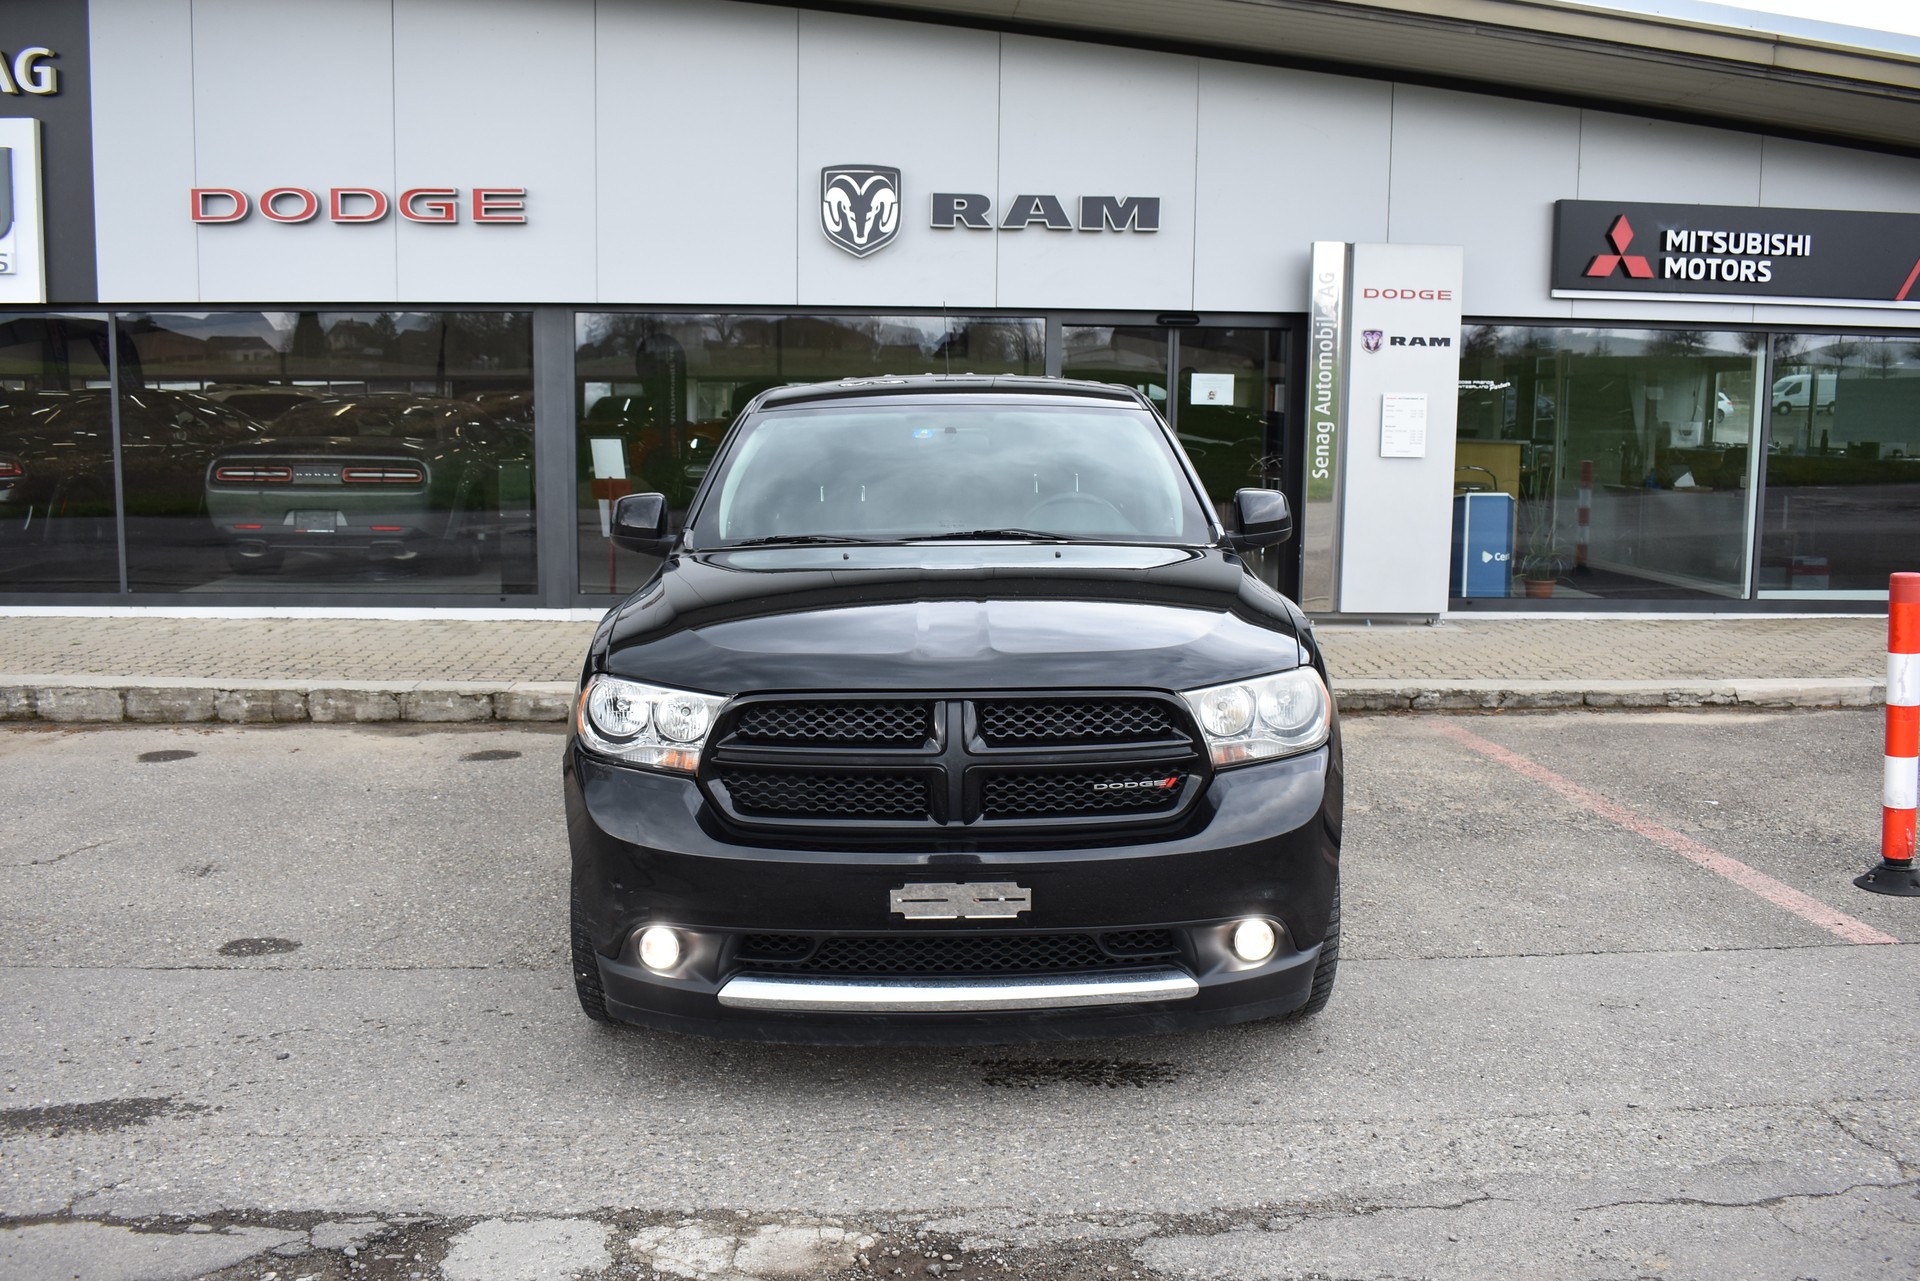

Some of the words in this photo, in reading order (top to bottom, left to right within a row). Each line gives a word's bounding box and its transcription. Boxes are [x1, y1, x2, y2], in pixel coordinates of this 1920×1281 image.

[190, 187, 527, 224] DODGE
[930, 192, 1161, 232] RAM
[1665, 229, 1811, 257] MITSUBISHI
[1664, 256, 1772, 283] MOTORS
[1318, 272, 1335, 298] AG
[1363, 288, 1452, 301] DODGE
[1389, 336, 1451, 347] RAM
[1314, 305, 1336, 416] Automobile
[1311, 421, 1335, 479] Senag
[1093, 779, 1167, 790] DODGE
